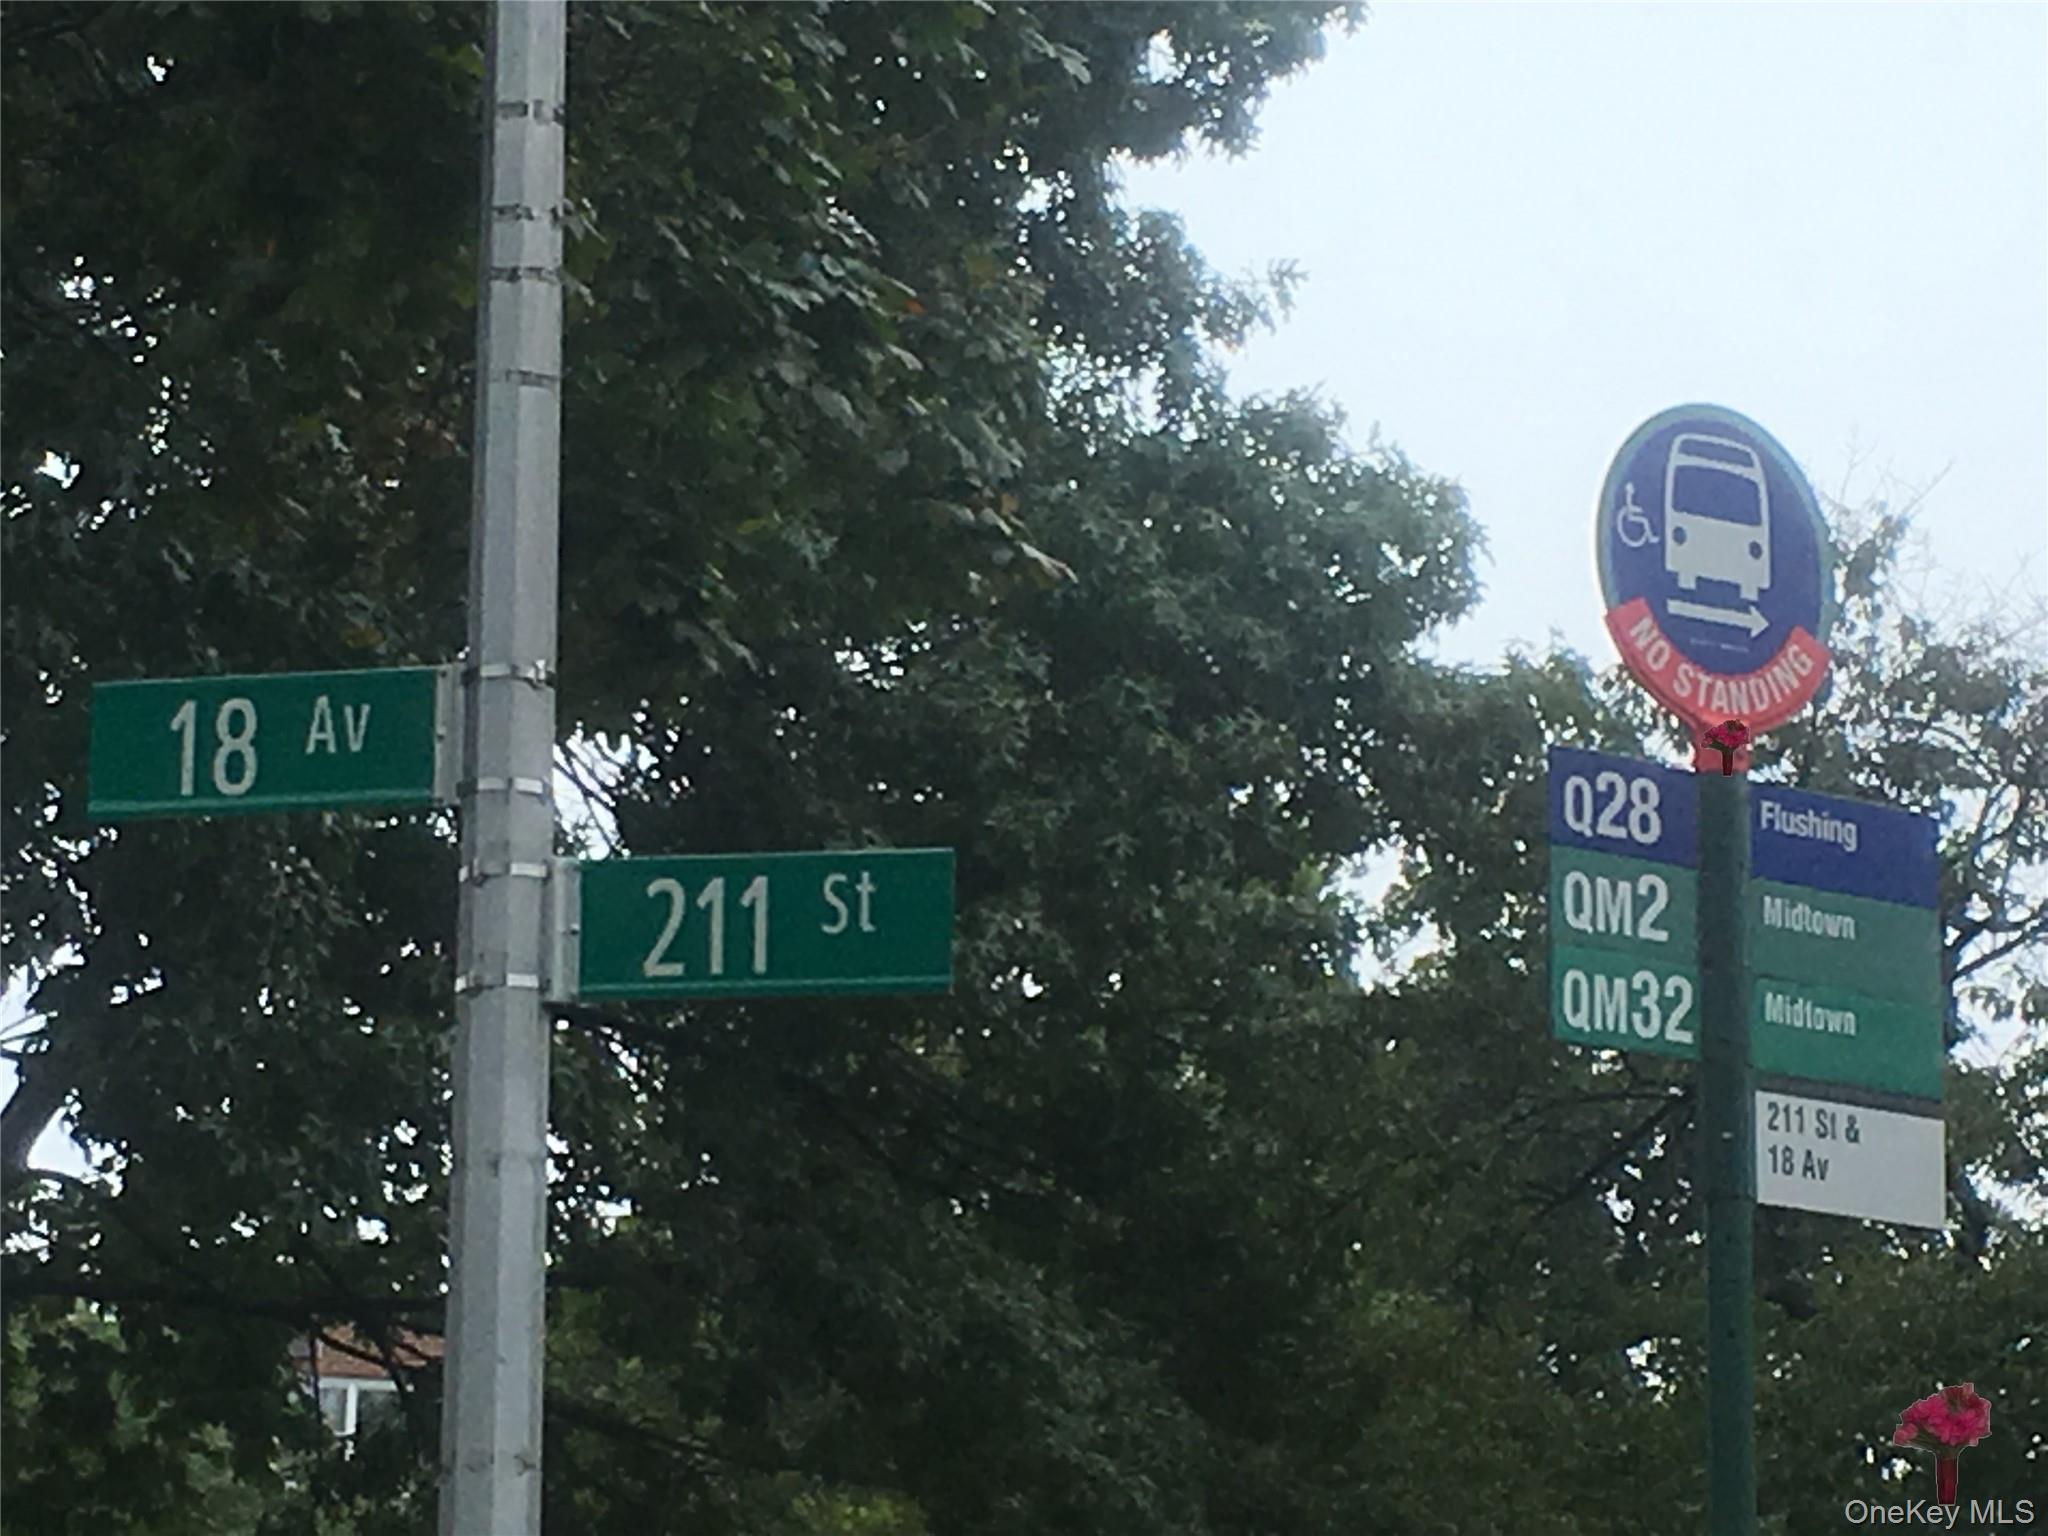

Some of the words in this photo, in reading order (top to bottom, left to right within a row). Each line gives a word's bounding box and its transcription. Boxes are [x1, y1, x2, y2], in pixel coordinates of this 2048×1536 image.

[1629, 617, 1671, 673] NO
[1673, 644, 1814, 715] STANDING
[168, 697, 259, 797] 18
[304, 694, 372, 756] Av
[1563, 771, 1662, 845] Q28
[1759, 800, 1858, 852] Flushing
[643, 876, 772, 978] 211
[821, 871, 877, 935] St
[1562, 870, 1670, 943] QM2
[1762, 895, 1856, 940] Midtown
[1562, 968, 1694, 1045] QM32
[1764, 991, 1857, 1036] Midtown
[1766, 1101, 1805, 1134] 211
[1814, 1109, 1838, 1140] St
[1844, 1115, 1860, 1144] &
[1767, 1145, 1794, 1176] 18
[1802, 1148, 1830, 1181] Av
